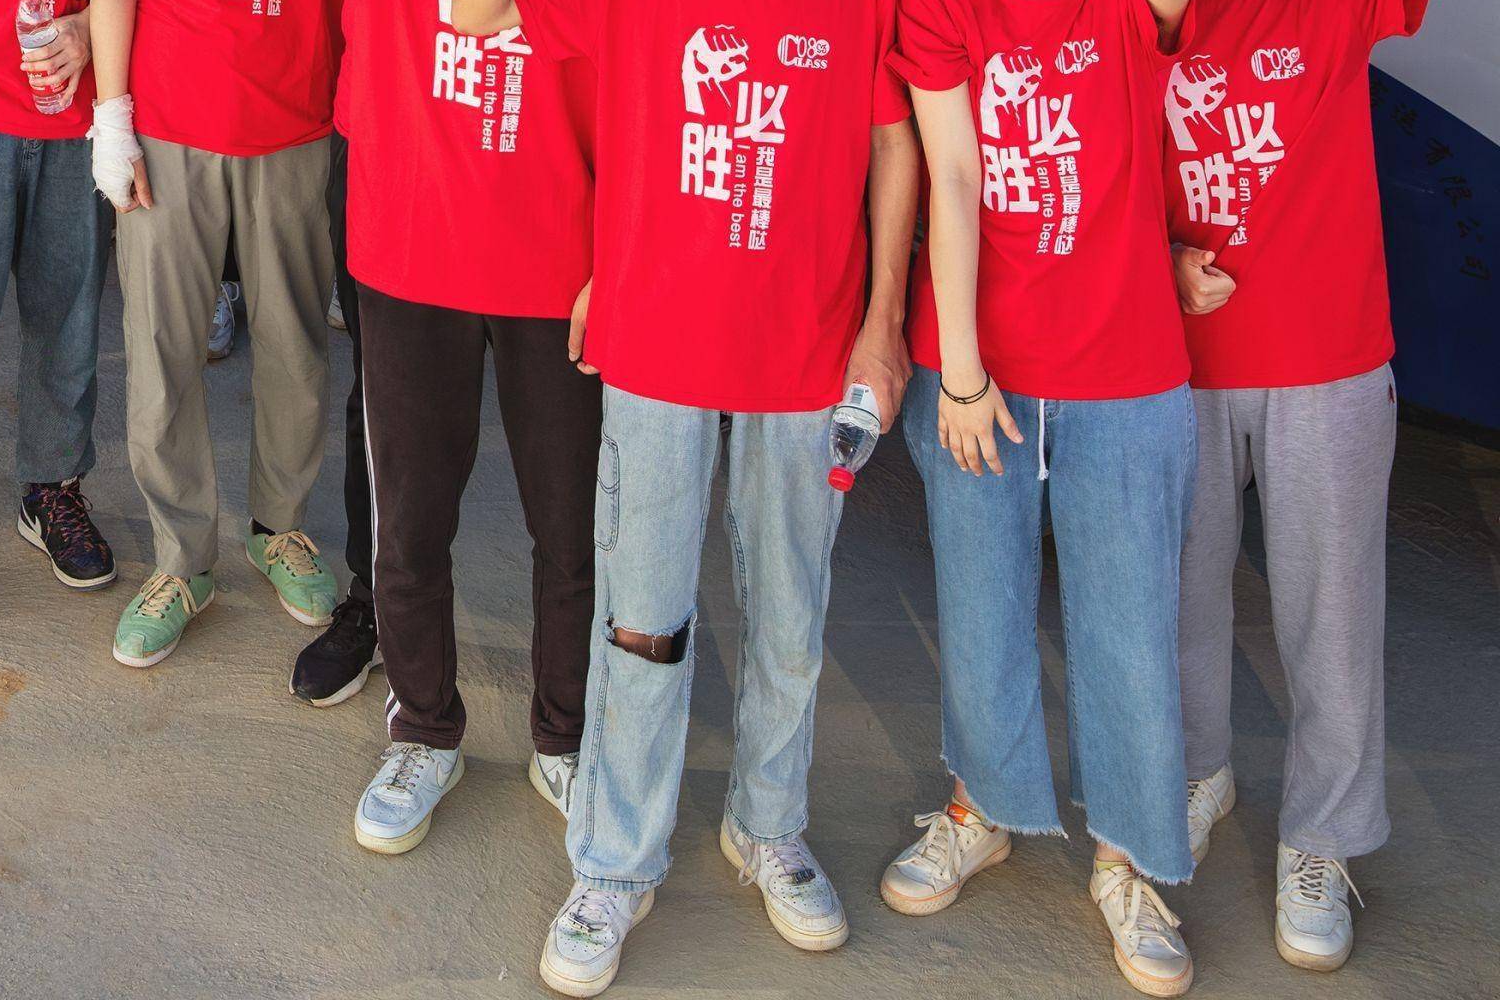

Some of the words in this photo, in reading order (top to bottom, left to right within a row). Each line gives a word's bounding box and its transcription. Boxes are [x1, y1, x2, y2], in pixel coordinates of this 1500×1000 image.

[431, 30, 485, 108] 胜
[484, 63, 498, 88] am
[483, 91, 498, 115] the
[733, 81, 790, 144] 必
[481, 118, 497, 150] best
[1026, 93, 1082, 158] 必
[1223, 101, 1285, 164] 必
[680, 121, 734, 201] 胜
[734, 154, 748, 179] am
[981, 143, 1040, 213] 胜
[1036, 166, 1051, 190] am
[1178, 151, 1239, 227] 胜
[1238, 177, 1252, 202] am
[732, 182, 748, 209] the
[1041, 192, 1057, 218] the
[729, 212, 746, 248] best
[1036, 222, 1056, 254] best
